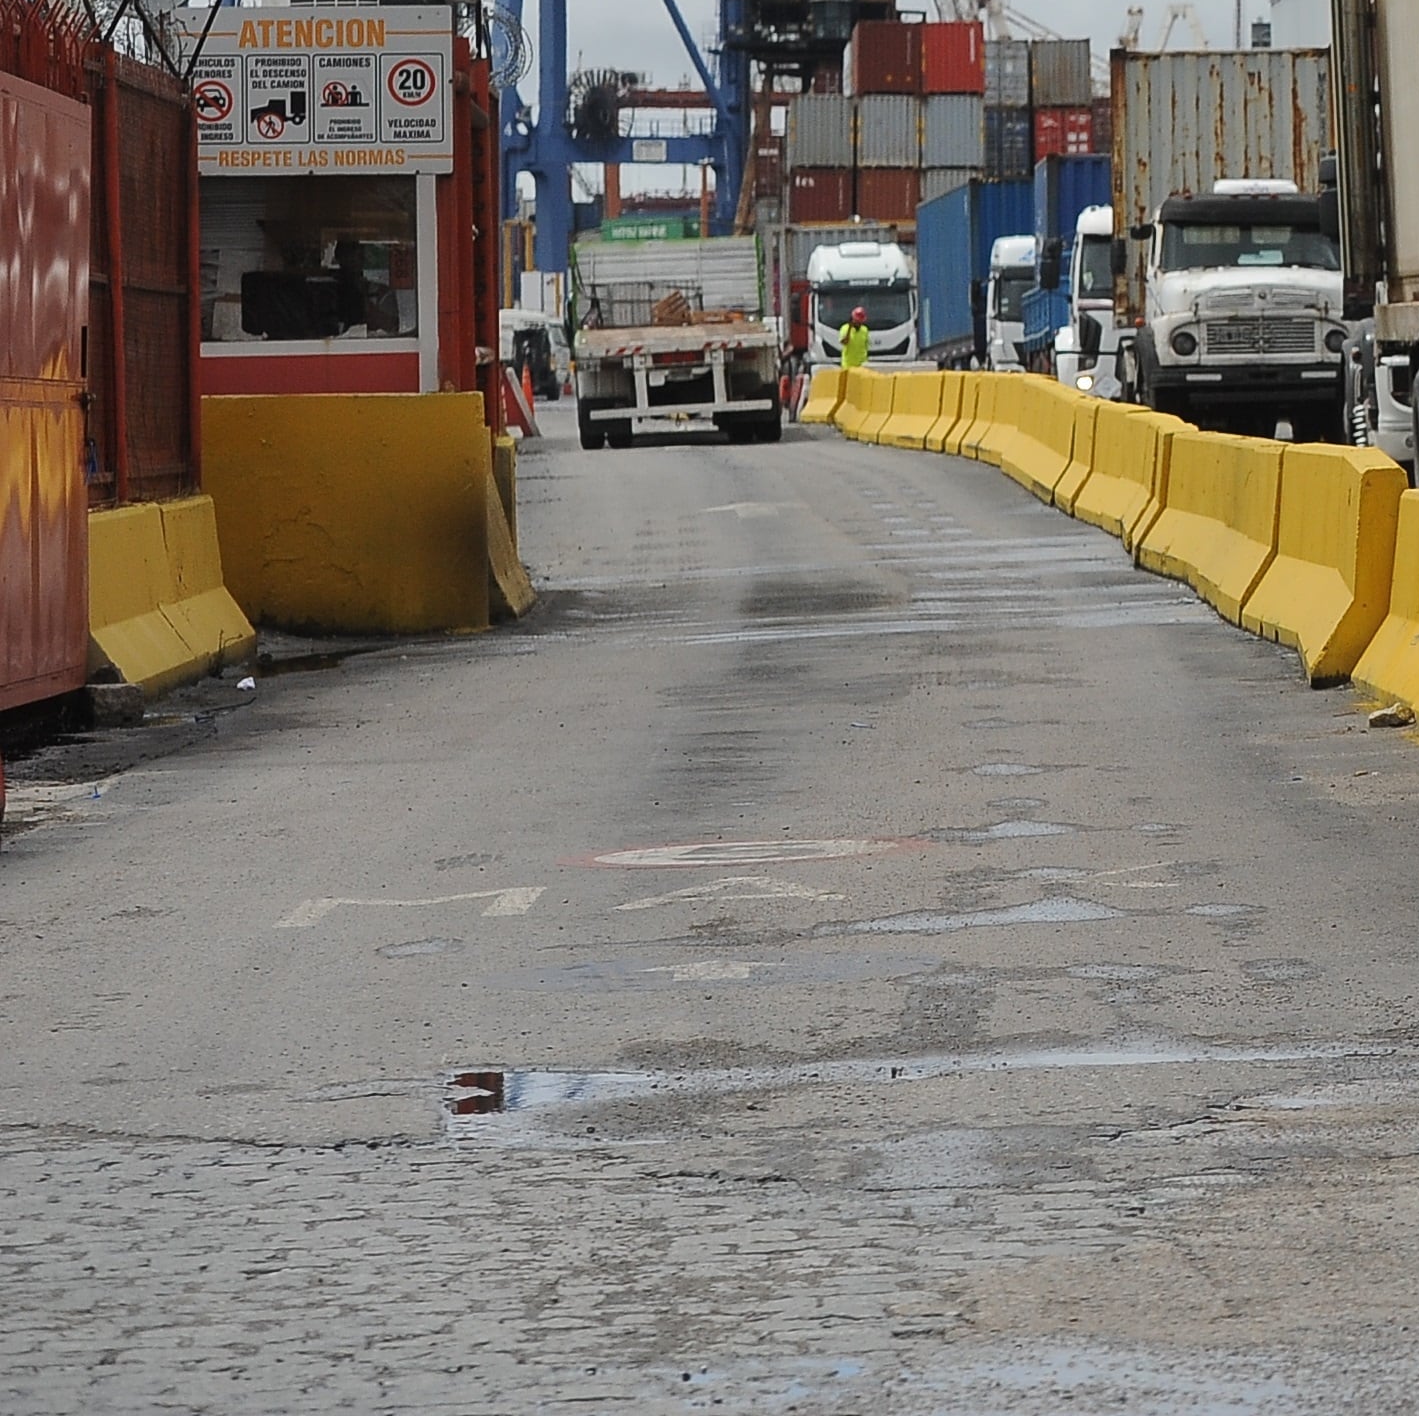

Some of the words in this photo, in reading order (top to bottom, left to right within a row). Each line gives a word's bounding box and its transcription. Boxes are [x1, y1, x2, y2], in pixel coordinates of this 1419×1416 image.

[239, 19, 385, 48] ATENCION
[254, 58, 302, 67] PROHIBIDO
[318, 57, 371, 68] CAMIONES
[249, 70, 261, 79] EL
[262, 69, 307, 78] DESCENSO
[252, 80, 267, 89] DEL
[270, 79, 305, 89] CAMION
[398, 69, 426, 91] 20
[388, 118, 437, 129] VELOCIDAD
[393, 129, 431, 139] MAXIMA
[218, 151, 292, 168] RESPETE
[298, 150, 328, 167] LAS
[334, 148, 405, 167] NORMAS
